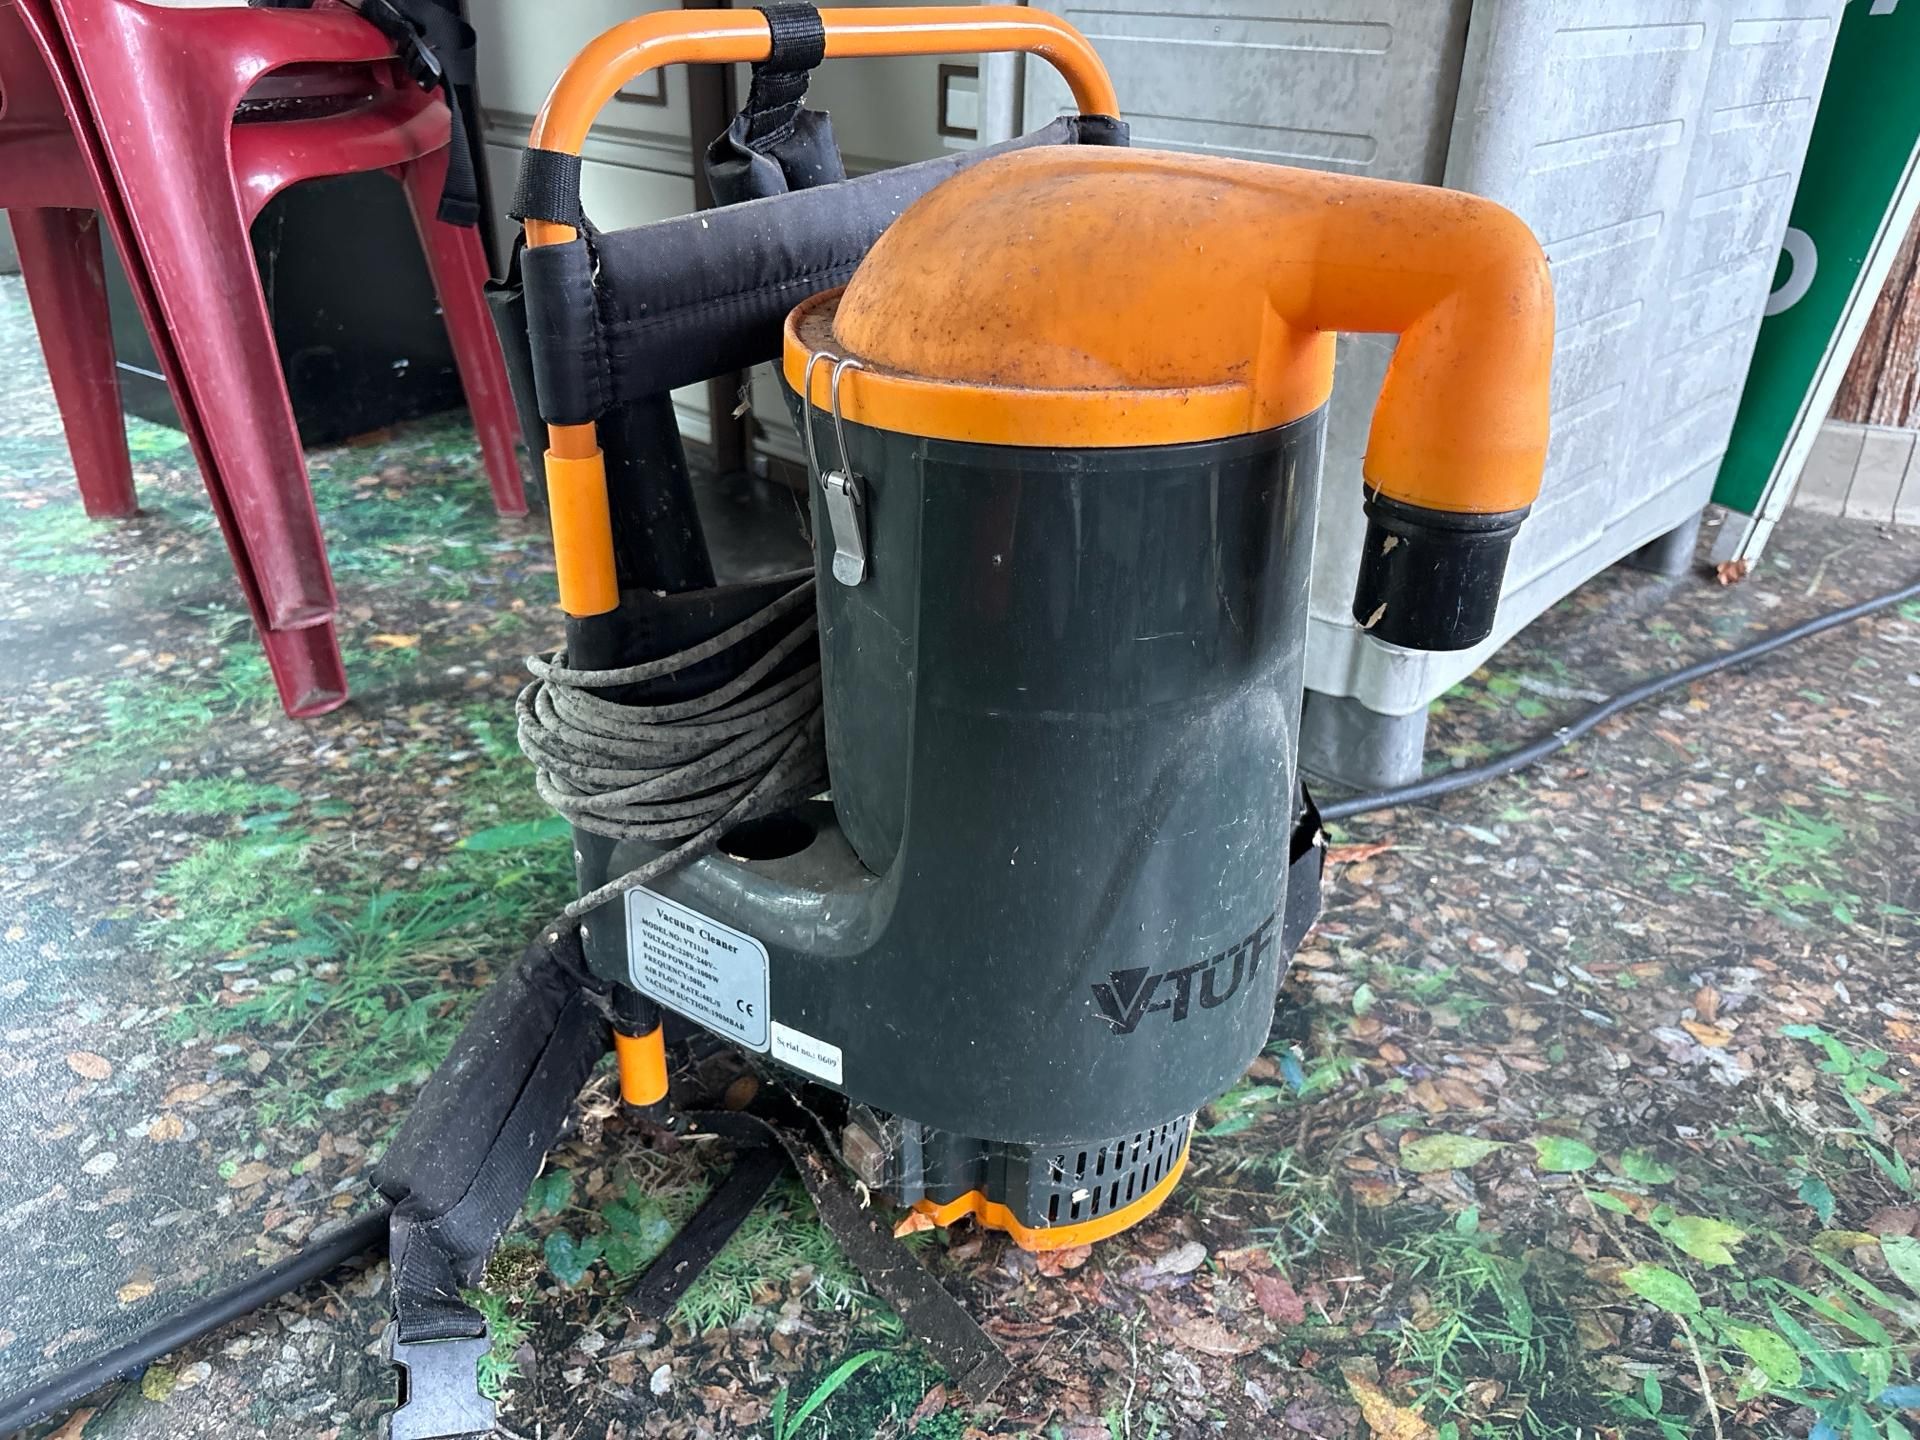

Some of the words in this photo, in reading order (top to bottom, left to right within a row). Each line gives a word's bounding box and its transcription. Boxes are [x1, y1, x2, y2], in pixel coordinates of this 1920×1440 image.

[641, 917, 668, 936] MODEL
[683, 937, 709, 955] VT1110
[656, 907, 695, 934] Vacuum
[699, 929, 739, 954] Cleaner
[643, 941, 667, 958] RATED
[644, 965, 657, 976] AIR
[658, 971, 679, 985] FLOW
[645, 975, 675, 996] VACUUM
[736, 999, 753, 1018] CE
[777, 1036, 799, 1052] Serial
[817, 1054, 837, 1067] 0609
